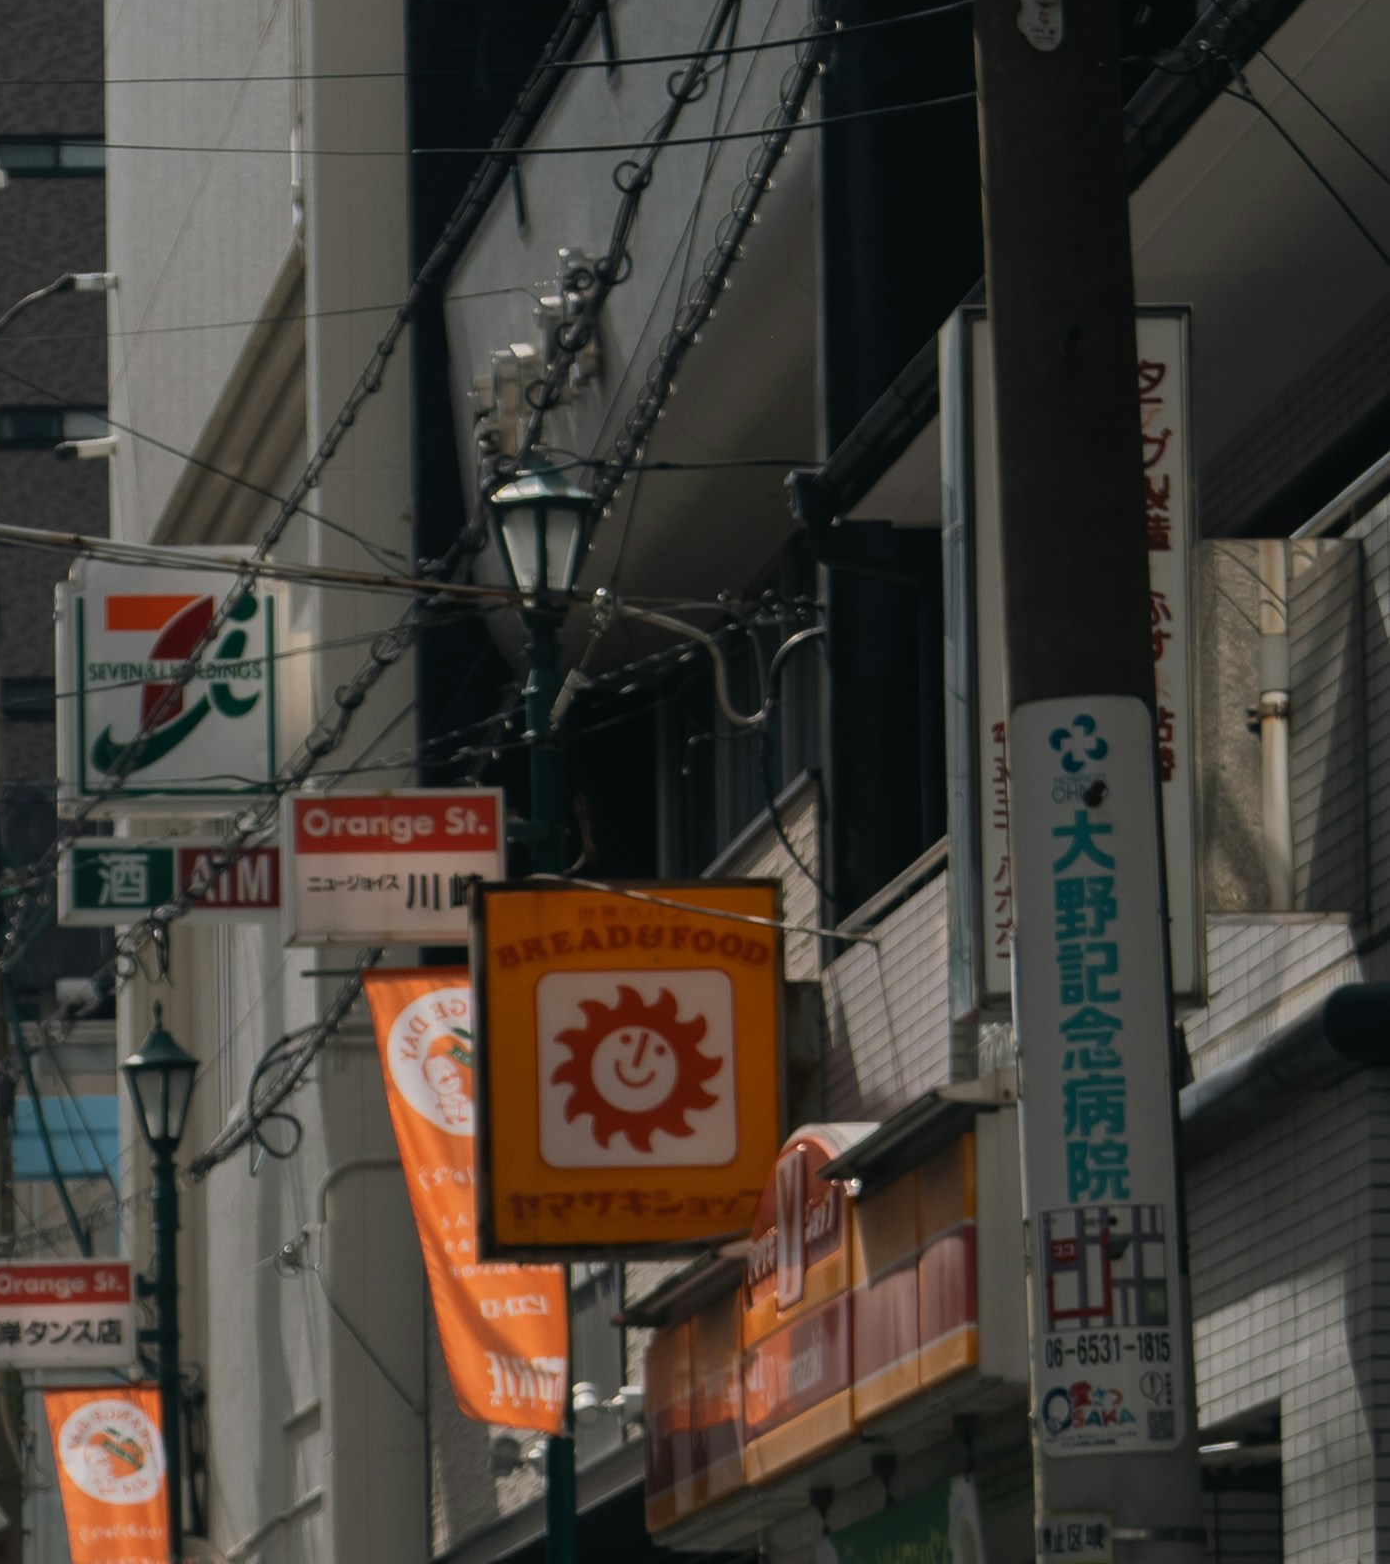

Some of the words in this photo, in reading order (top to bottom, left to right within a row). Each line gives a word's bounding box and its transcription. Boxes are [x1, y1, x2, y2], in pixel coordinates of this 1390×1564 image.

[302, 807, 435, 844] Orange
[444, 805, 490, 836] St.
[98, 853, 150, 907] 酒
[187, 852, 269, 903] ATM
[497, 924, 768, 969] BREAD&FOOD
[1050, 810, 1133, 1205] 大野記念病院
[93, 1270, 123, 1293] St.
[1045, 1332, 1171, 1369] 06-6531-1815
